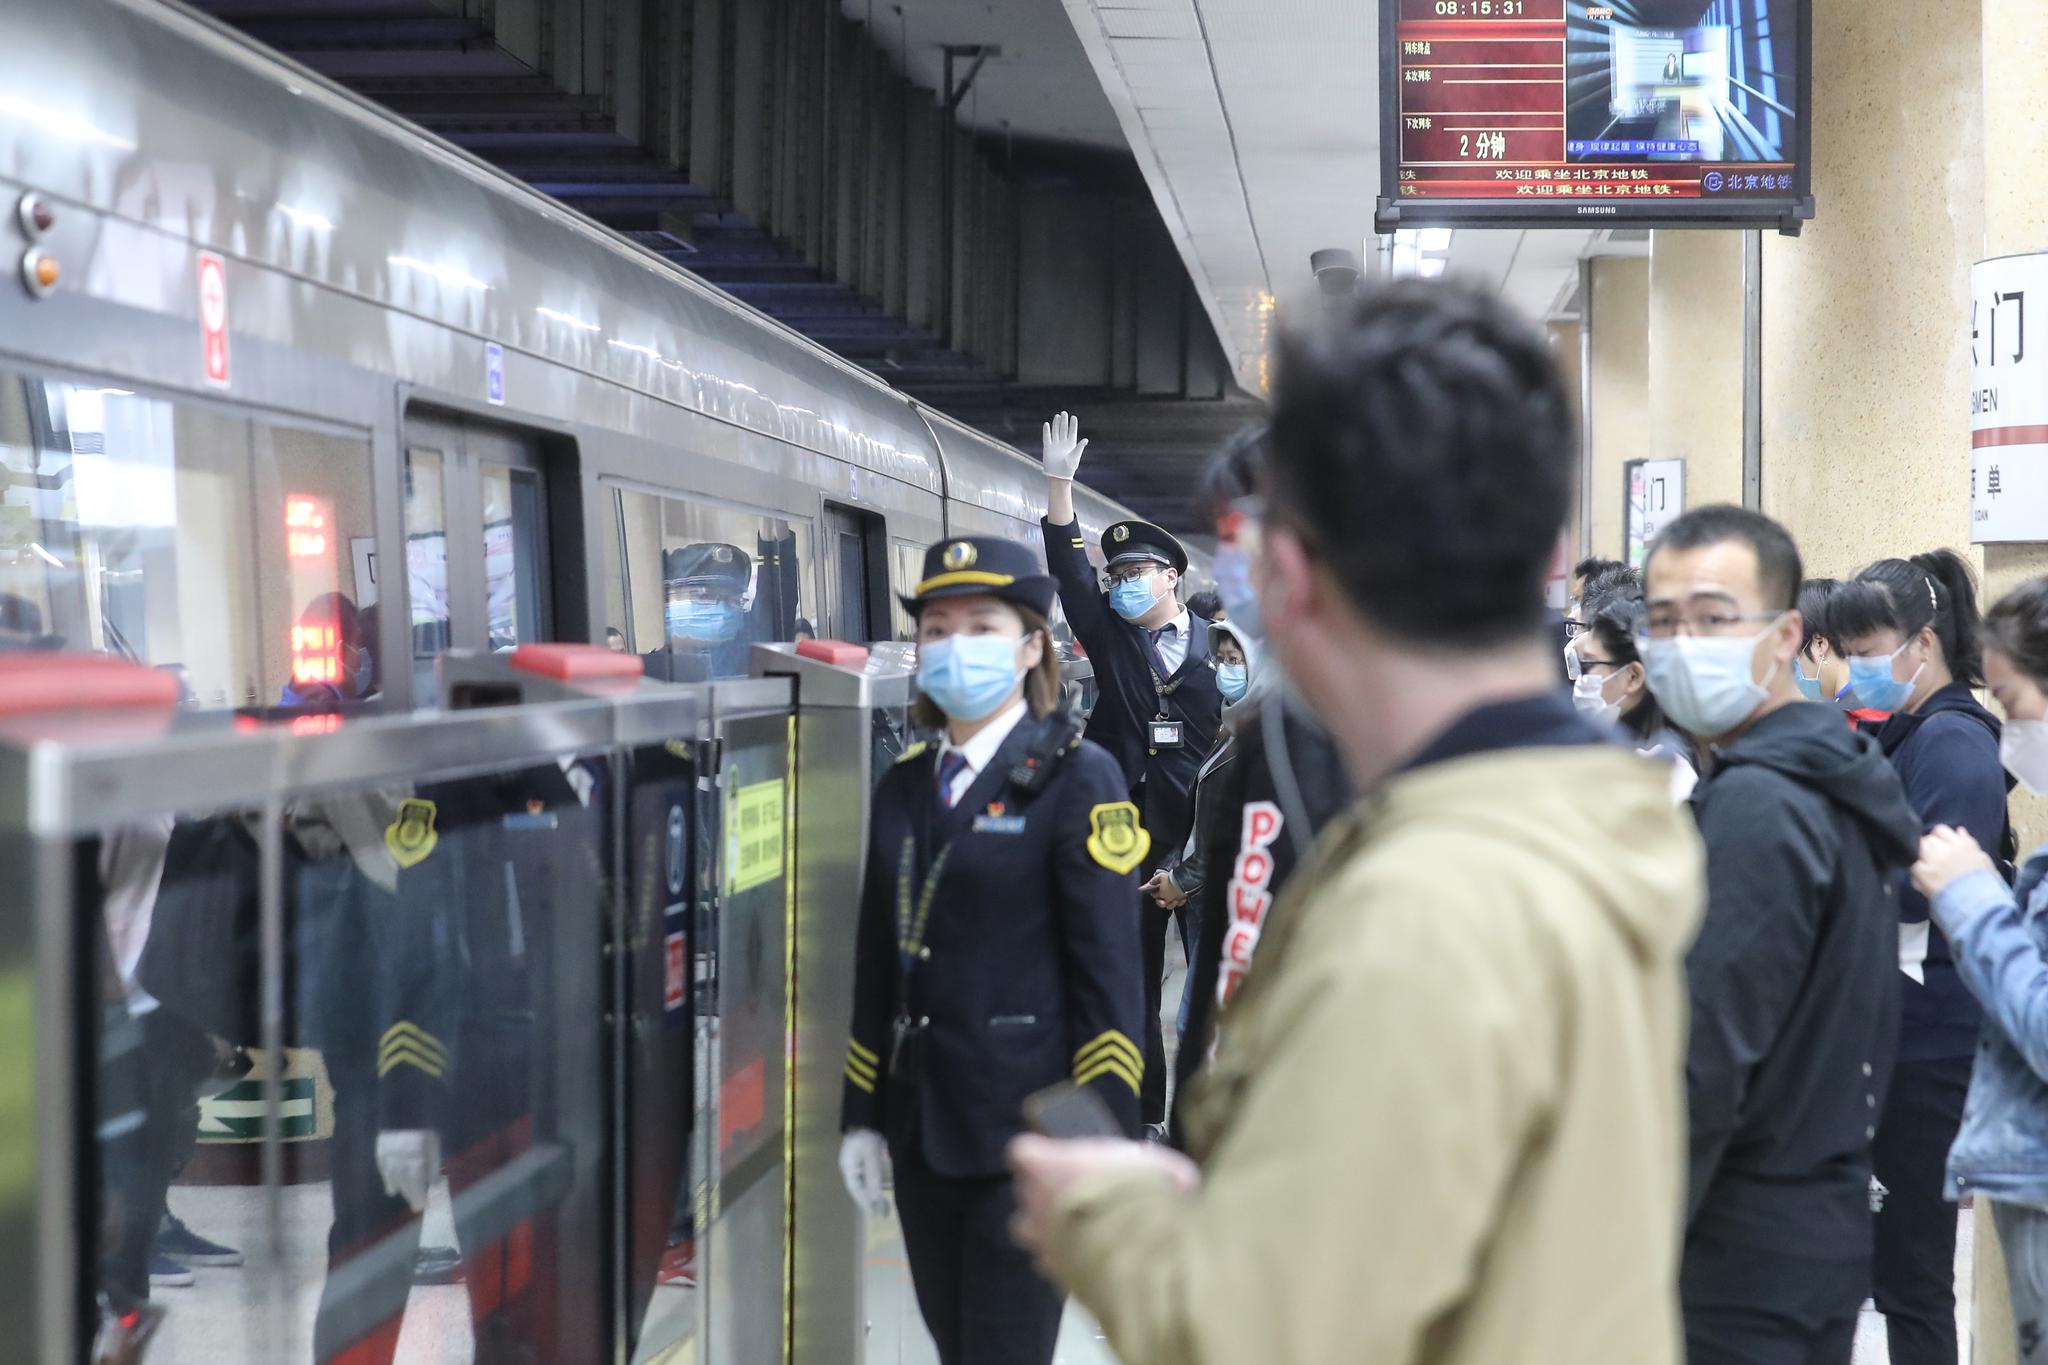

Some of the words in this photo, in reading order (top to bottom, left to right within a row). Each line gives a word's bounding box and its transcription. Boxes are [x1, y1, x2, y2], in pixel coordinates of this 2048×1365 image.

[1435, 1, 1524, 15] 08:15:31
[1404, 41, 1431, 55] 列车终点
[1404, 70, 1432, 82] 本次列车
[1405, 117, 1432, 130] 下次列车
[1460, 134, 1469, 156] 2
[1476, 131, 1506, 159] 分钟
[1495, 168, 1649, 180] 欢迎乘坐北京地铁
[1727, 173, 1793, 190] 北京地铁
[1577, 206, 1616, 214] SAMSUNG
